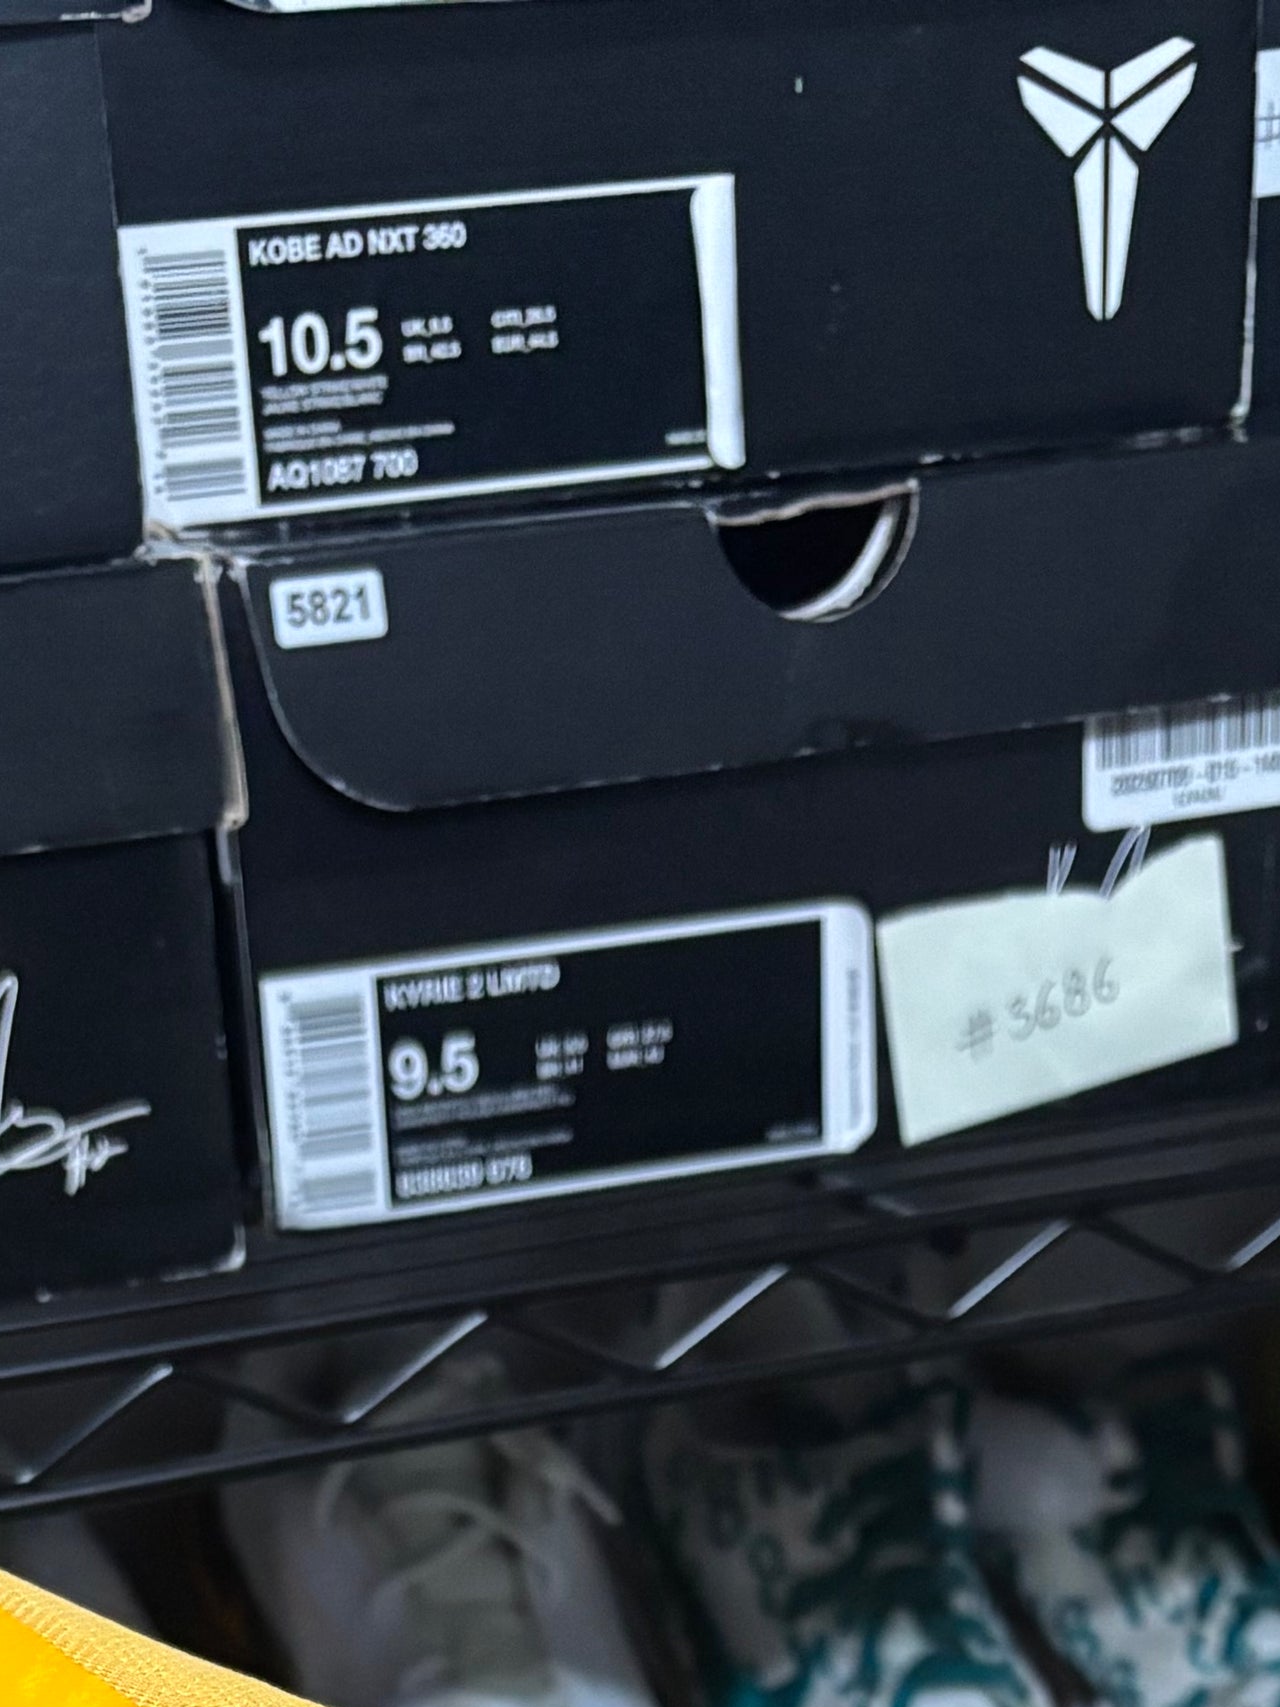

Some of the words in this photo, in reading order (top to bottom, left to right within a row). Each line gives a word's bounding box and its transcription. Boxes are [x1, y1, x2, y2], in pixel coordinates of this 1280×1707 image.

[249, 233, 322, 267] KOBE
[325, 229, 364, 260] AD
[367, 224, 419, 256] NXT
[422, 221, 467, 251] 360
[258, 306, 384, 377] 10.5
[287, 584, 370, 628] 5821
[955, 955, 1119, 1062] #3686
[388, 1029, 479, 1100] 9.5
